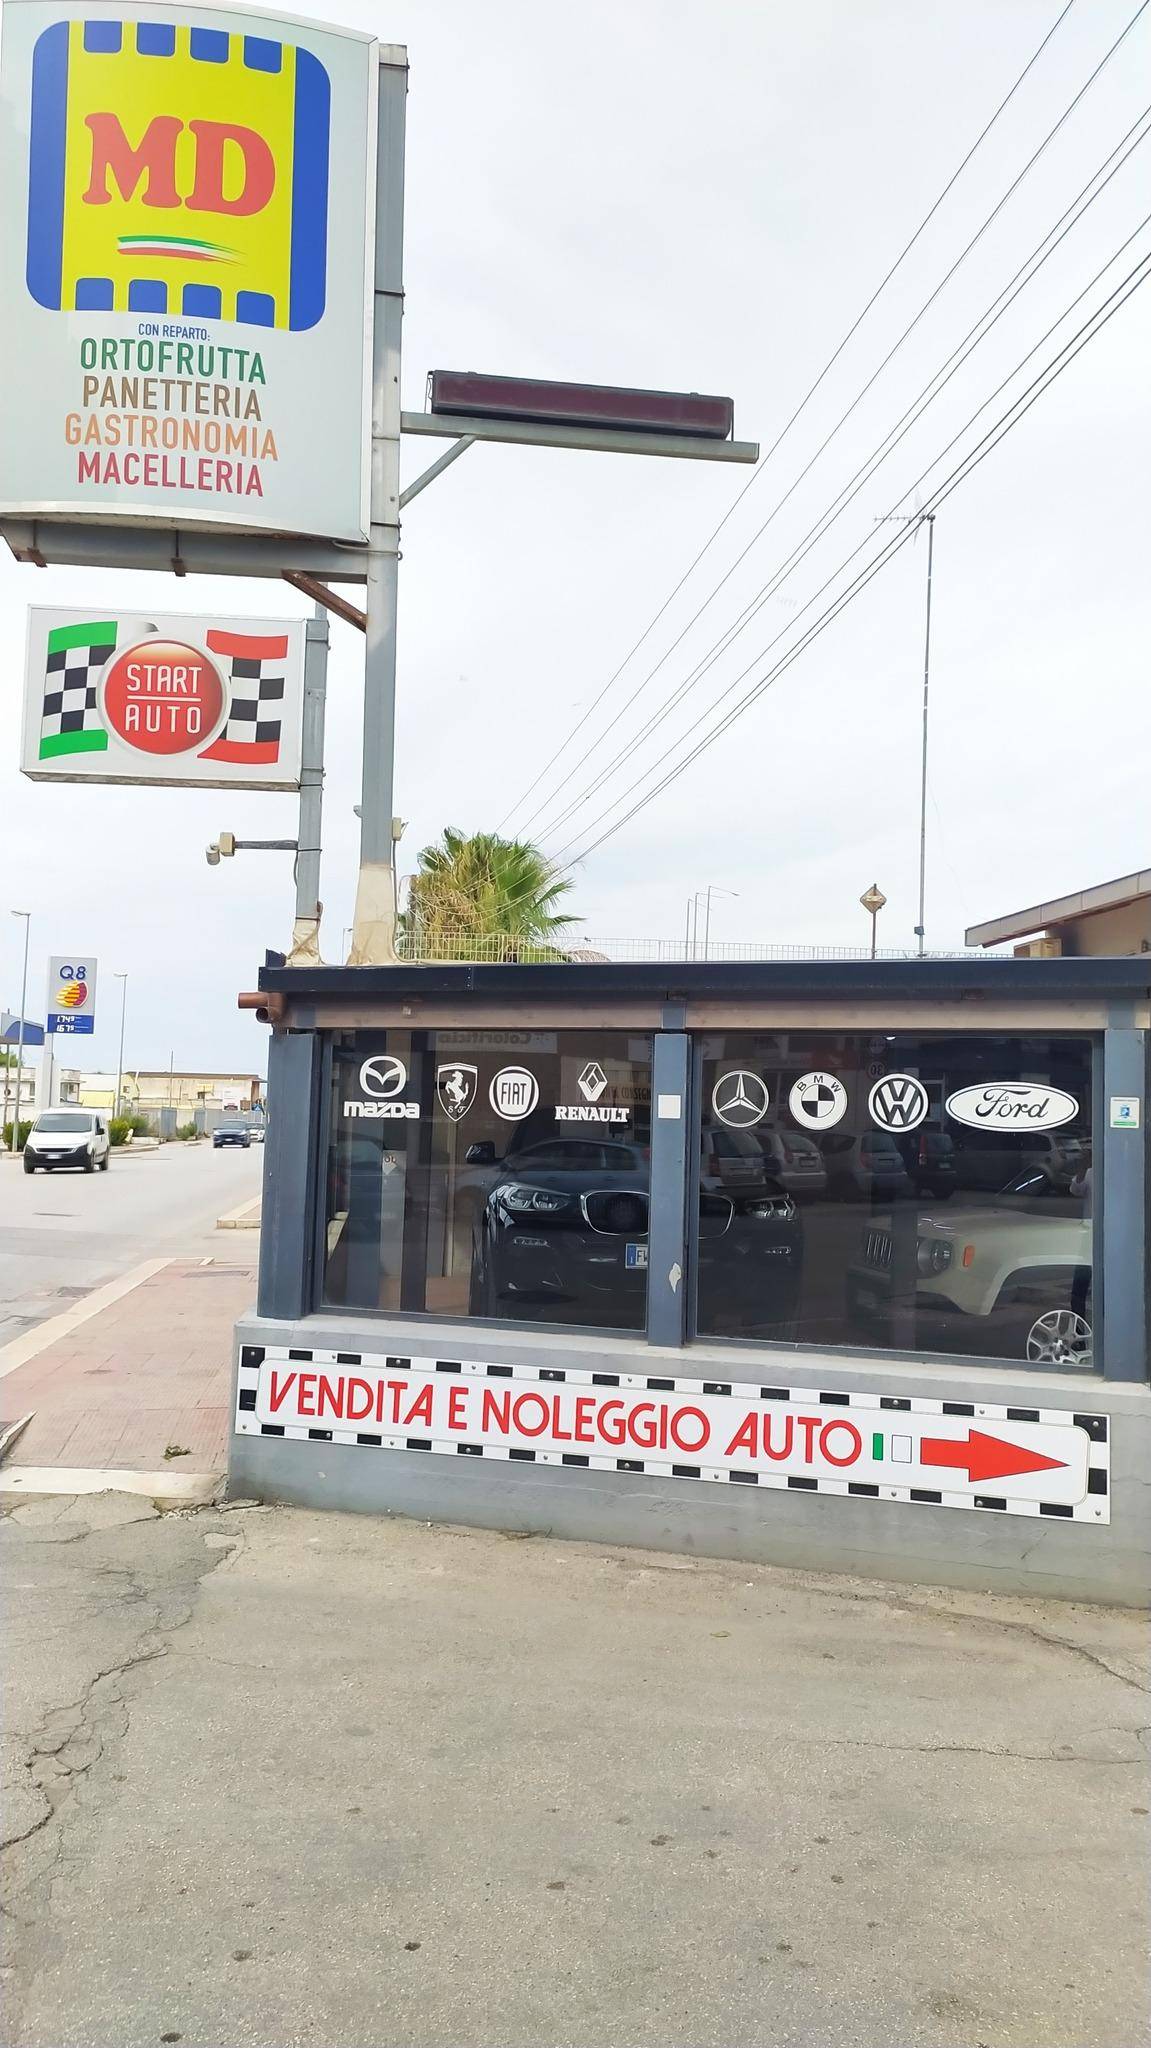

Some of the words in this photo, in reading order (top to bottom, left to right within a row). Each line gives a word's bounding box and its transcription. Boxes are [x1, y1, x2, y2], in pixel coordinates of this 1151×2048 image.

[82, 112, 276, 217] MD
[138, 323, 160, 337] CON
[162, 325, 211, 341] REPARTO:
[80, 338, 266, 385] ORTOFRUTTA
[82, 375, 262, 422] PANETTERIA
[64, 413, 279, 462] GASTRONOMIA
[77, 452, 264, 497] MACELLERIA
[126, 664, 202, 694] START
[125, 704, 201, 733] AUTO
[60, 965, 87, 980] Q8
[501, 1082, 527, 1106] FIAT
[796, 1074, 842, 1094] BMW
[554, 1105, 630, 1123] RENAULT
[975, 1088, 1050, 1118] Ford
[269, 1370, 434, 1427] VENDITA
[448, 1386, 469, 1431] E
[482, 1389, 711, 1453] NOLEGGIO
[724, 1412, 862, 1467] AUTO
